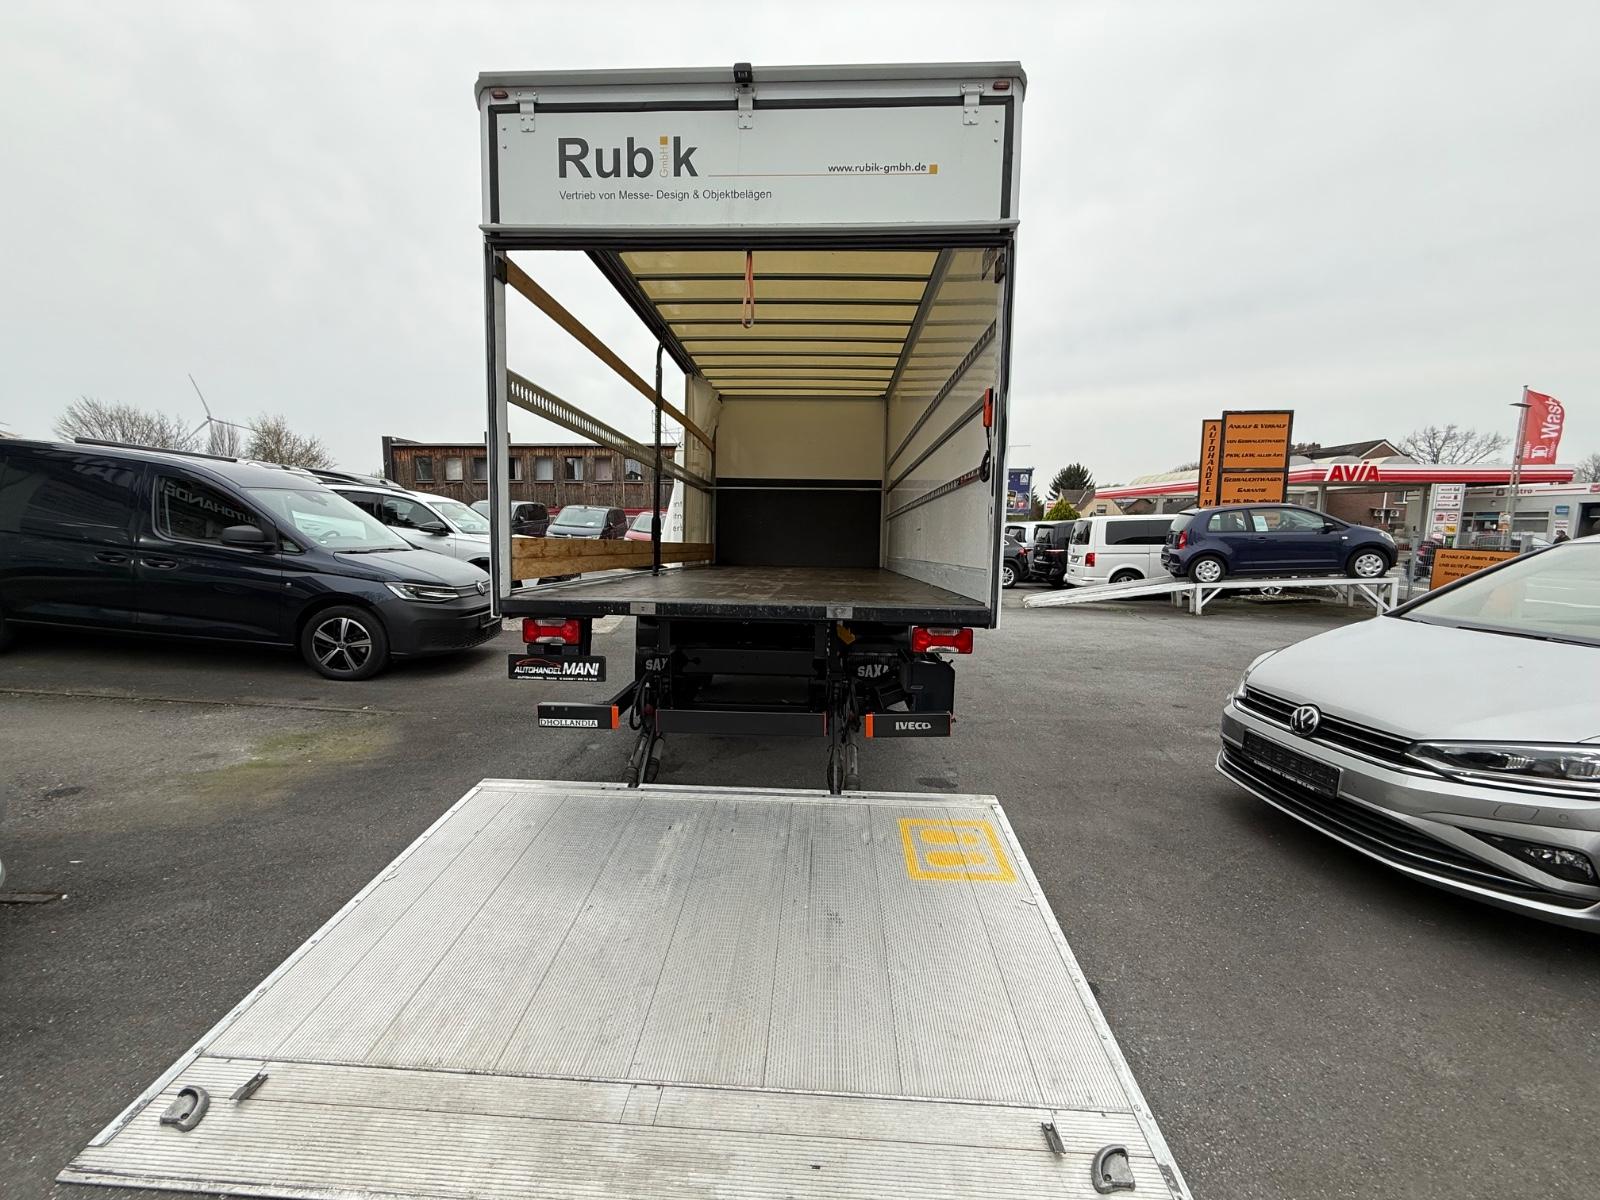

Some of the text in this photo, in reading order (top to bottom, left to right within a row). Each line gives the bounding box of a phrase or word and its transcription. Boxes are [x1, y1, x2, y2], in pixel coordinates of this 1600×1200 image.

[659, 147, 669, 178] GmbH
[827, 162, 927, 174] www.rubik-gmbh.de
[559, 189, 772, 201] Vertrieb von Messe- Design & Objektbelägen
[1327, 460, 1380, 482] AVIA
[514, 662, 599, 676] AUTOHANDEL MANI
[540, 719, 597, 727] DHOLLANDIA
[895, 721, 931, 731] IVECO
